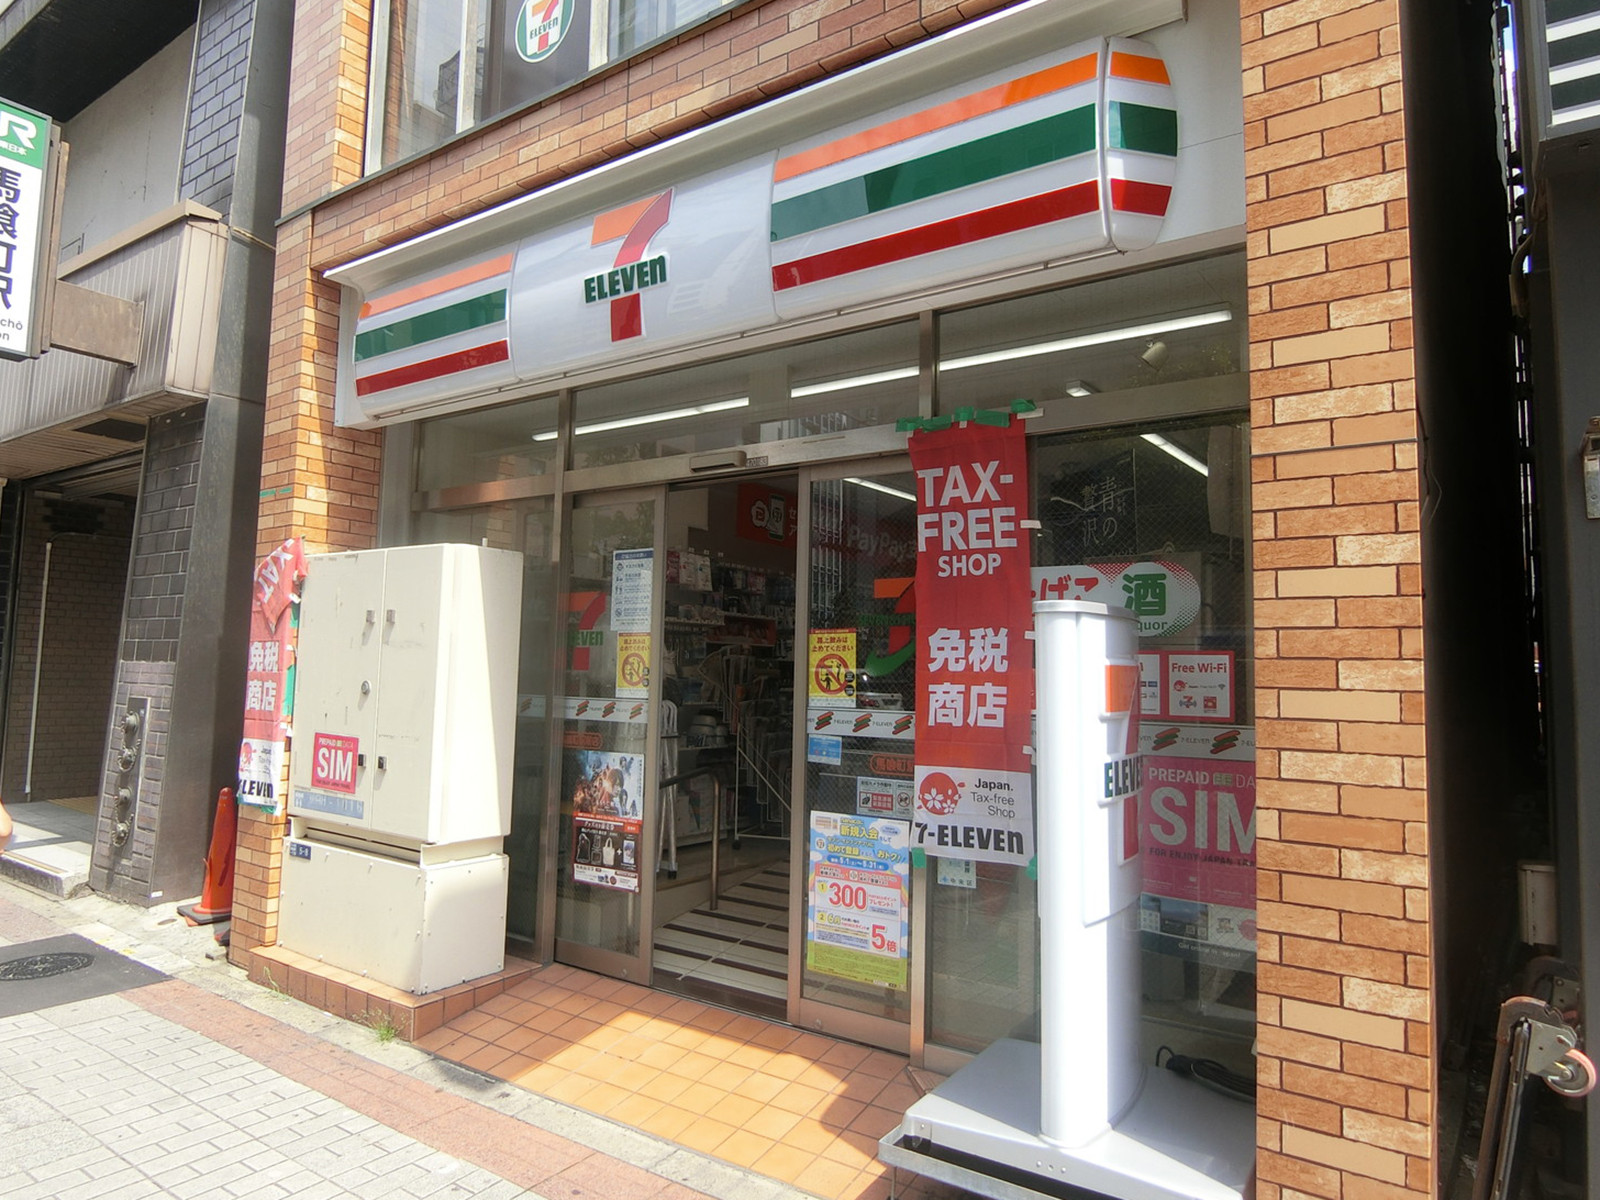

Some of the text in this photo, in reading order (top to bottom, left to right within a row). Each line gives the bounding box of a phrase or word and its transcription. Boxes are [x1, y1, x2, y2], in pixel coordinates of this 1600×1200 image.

[530, 17, 558, 40] ELEVEN
[584, 255, 667, 304] ELEVEN
[916, 460, 1014, 508] TAX-
[917, 507, 1018, 552] FREE
[938, 553, 1001, 578] SHOP
[1122, 573, 1167, 617] 酒
[1137, 620, 1168, 632] quor
[928, 627, 1008, 673] 免税
[1172, 662, 1227, 674] Free Wi-Fi
[246, 680, 276, 712] 商店
[927, 682, 1008, 728] 商店
[317, 747, 354, 782] SIM
[1148, 767, 1256, 788] PREPAID DA
[970, 792, 1014, 806] Tax-free
[974, 778, 1014, 792] Japan.
[988, 805, 1016, 820] Shop
[840, 826, 878, 840] 新規入会
[914, 822, 1024, 855] 7-ELEVEN
[1150, 848, 1166, 857] FOR
[1170, 850, 1198, 861] ENJOY
[1203, 855, 1233, 866] JAPAN
[829, 882, 866, 910] 300
[872, 924, 886, 950] 5
[887, 941, 897, 952] 倍
